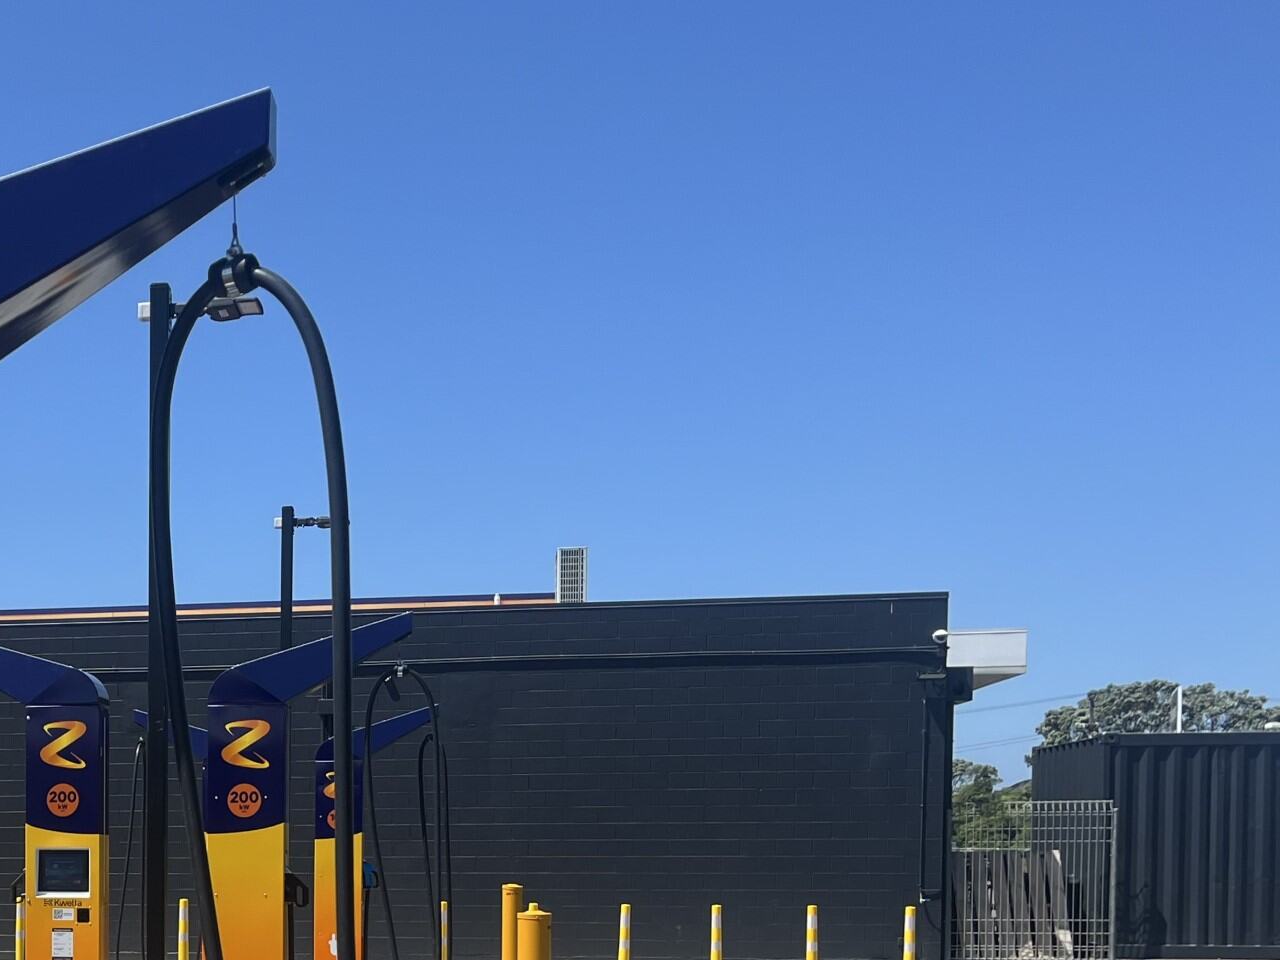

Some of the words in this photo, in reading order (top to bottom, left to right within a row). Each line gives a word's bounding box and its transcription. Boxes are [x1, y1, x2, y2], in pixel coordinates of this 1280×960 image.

[39, 720, 87, 769] Z
[221, 719, 271, 769] Z
[49, 791, 77, 803] 200
[230, 791, 259, 803] 200
